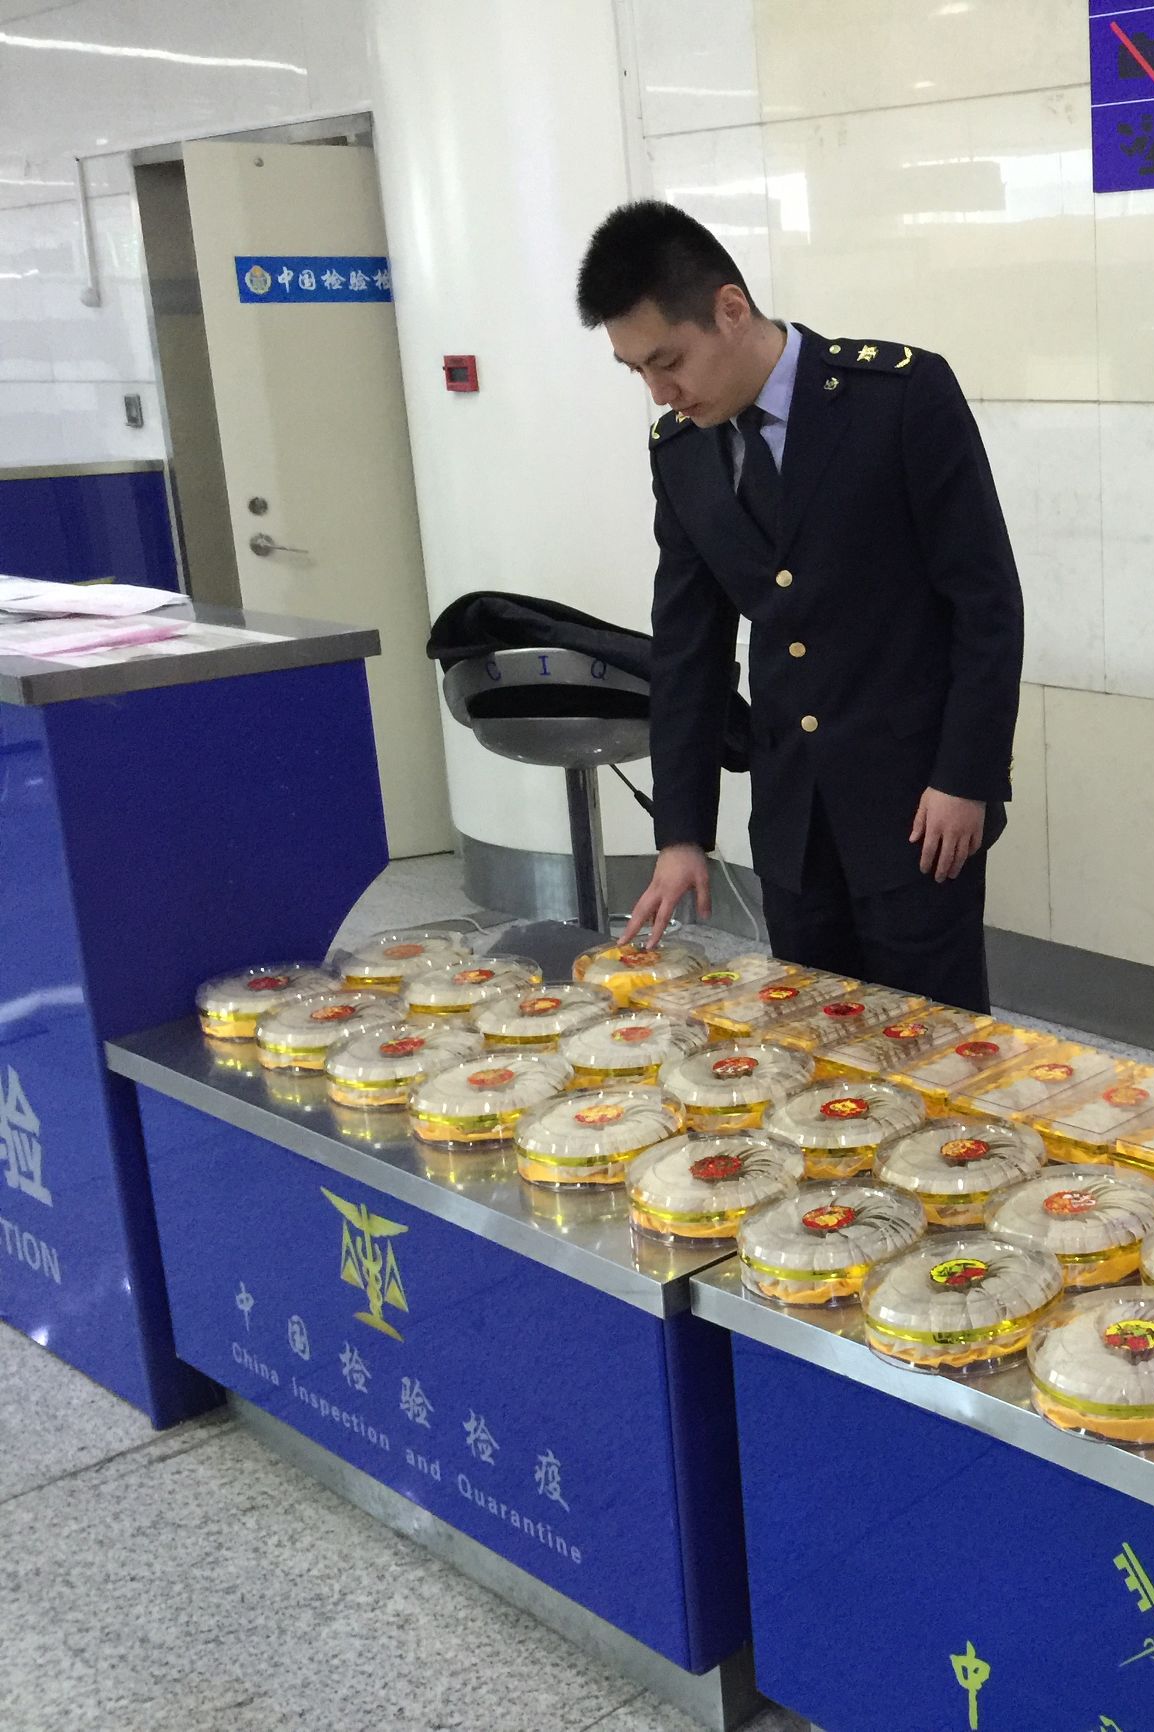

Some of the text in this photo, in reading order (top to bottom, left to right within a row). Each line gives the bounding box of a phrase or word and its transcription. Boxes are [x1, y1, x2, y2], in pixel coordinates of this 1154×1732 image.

[232, 1342, 582, 1564] China Inspection and Quarantine
